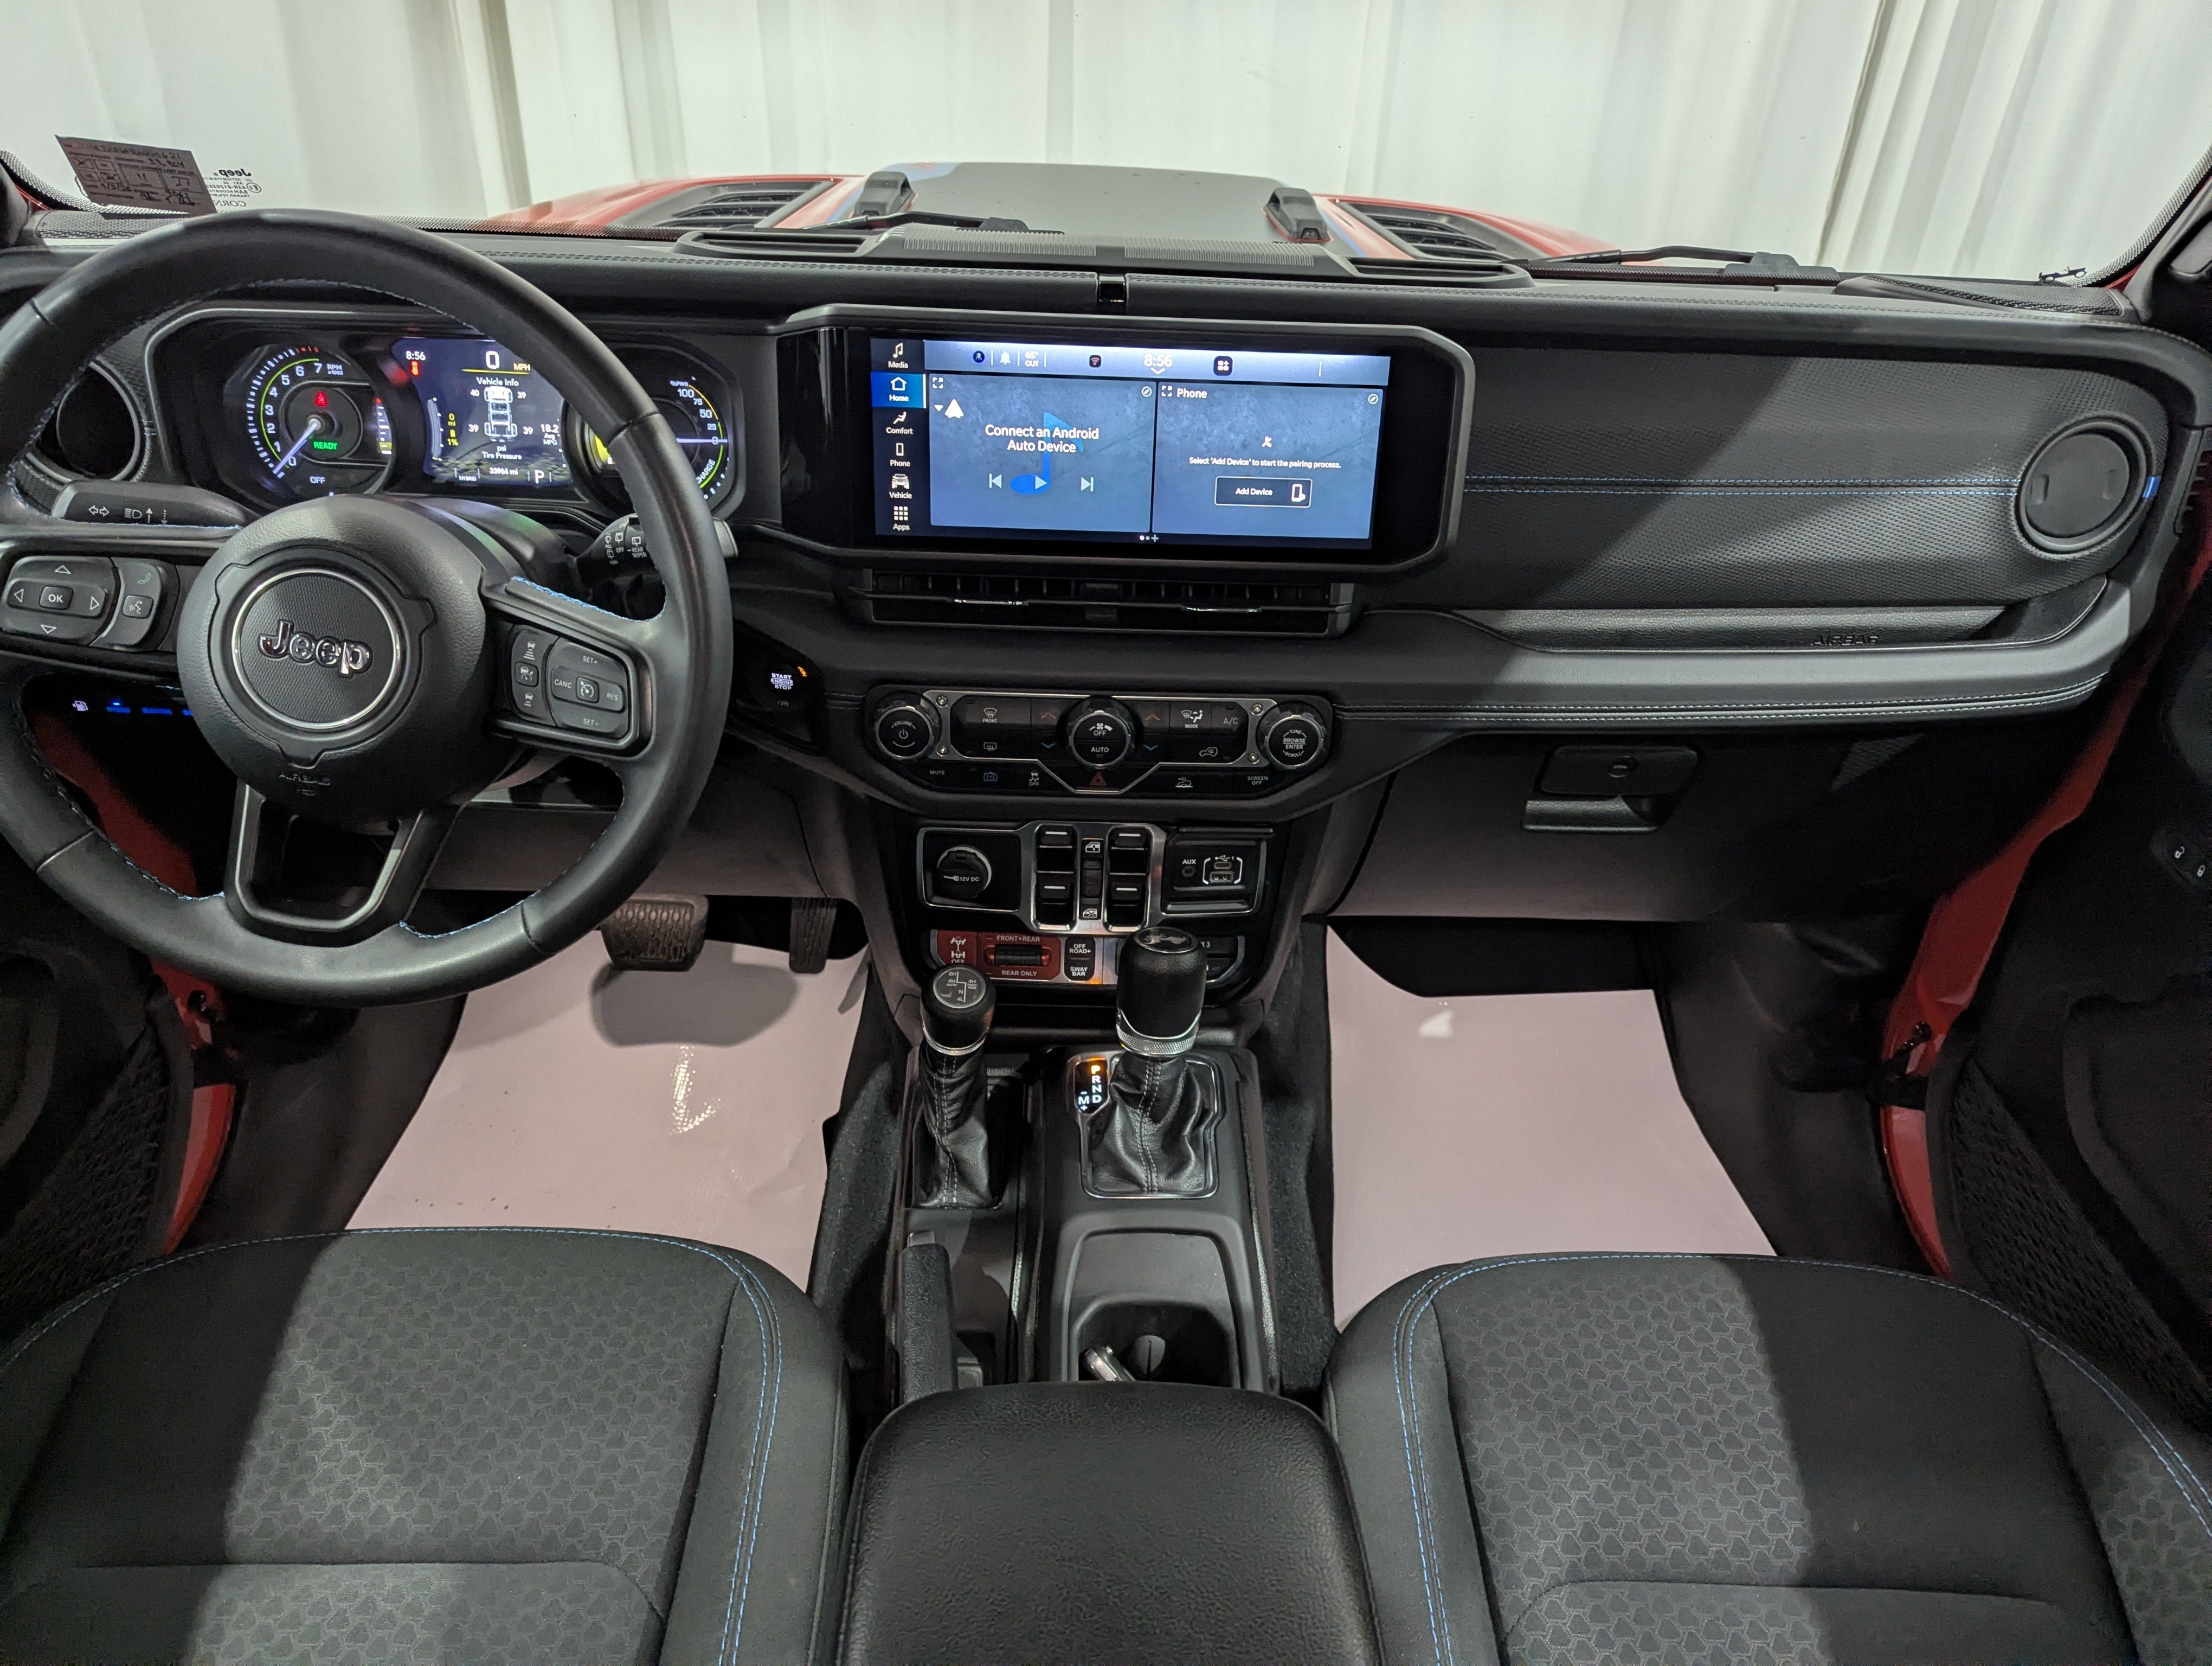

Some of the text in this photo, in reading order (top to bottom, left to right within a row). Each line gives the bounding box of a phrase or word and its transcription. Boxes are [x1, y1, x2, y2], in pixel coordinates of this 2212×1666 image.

[406, 351, 426, 360] 8:56
[486, 351, 500, 369] 0
[1143, 354, 1173, 367] 8:56
[295, 366, 305, 377] 6
[314, 363, 323, 373] 7
[281, 375, 290, 386] 5
[476, 377, 519, 387] Vehicle Info
[269, 387, 278, 398] 4
[677, 388, 695, 398] 100
[1176, 388, 1208, 399] Phone
[265, 405, 274, 415] 3
[699, 409, 712, 419] 50
[267, 423, 275, 433] 2
[541, 424, 559, 433] 18.2
[985, 424, 1099, 440] Connect an Android
[274, 441, 281, 452] 1
[313, 442, 338, 450] READY
[1007, 439, 1077, 453] Auto Device
[288, 456, 297, 466] 0
[1189, 457, 1209, 466] Select
[1289, 460, 1313, 470] pairing
[489, 467, 509, 475] 33964
[535, 470, 545, 484] P
[1235, 487, 1273, 496] Add Device
[893, 524, 910, 532] Apps
[48, 594, 63, 603] OK
[258, 619, 373, 678] Jeep
[554, 679, 572, 689] CANC
[606, 693, 619, 701] RES
[1223, 717, 1238, 725] A/C
[1091, 1065, 1101, 1074] P
[1092, 1075, 1101, 1084] R
[1092, 1085, 1102, 1093] N
[1078, 1095, 1090, 1105] M
[1092, 1094, 1102, 1103] D
